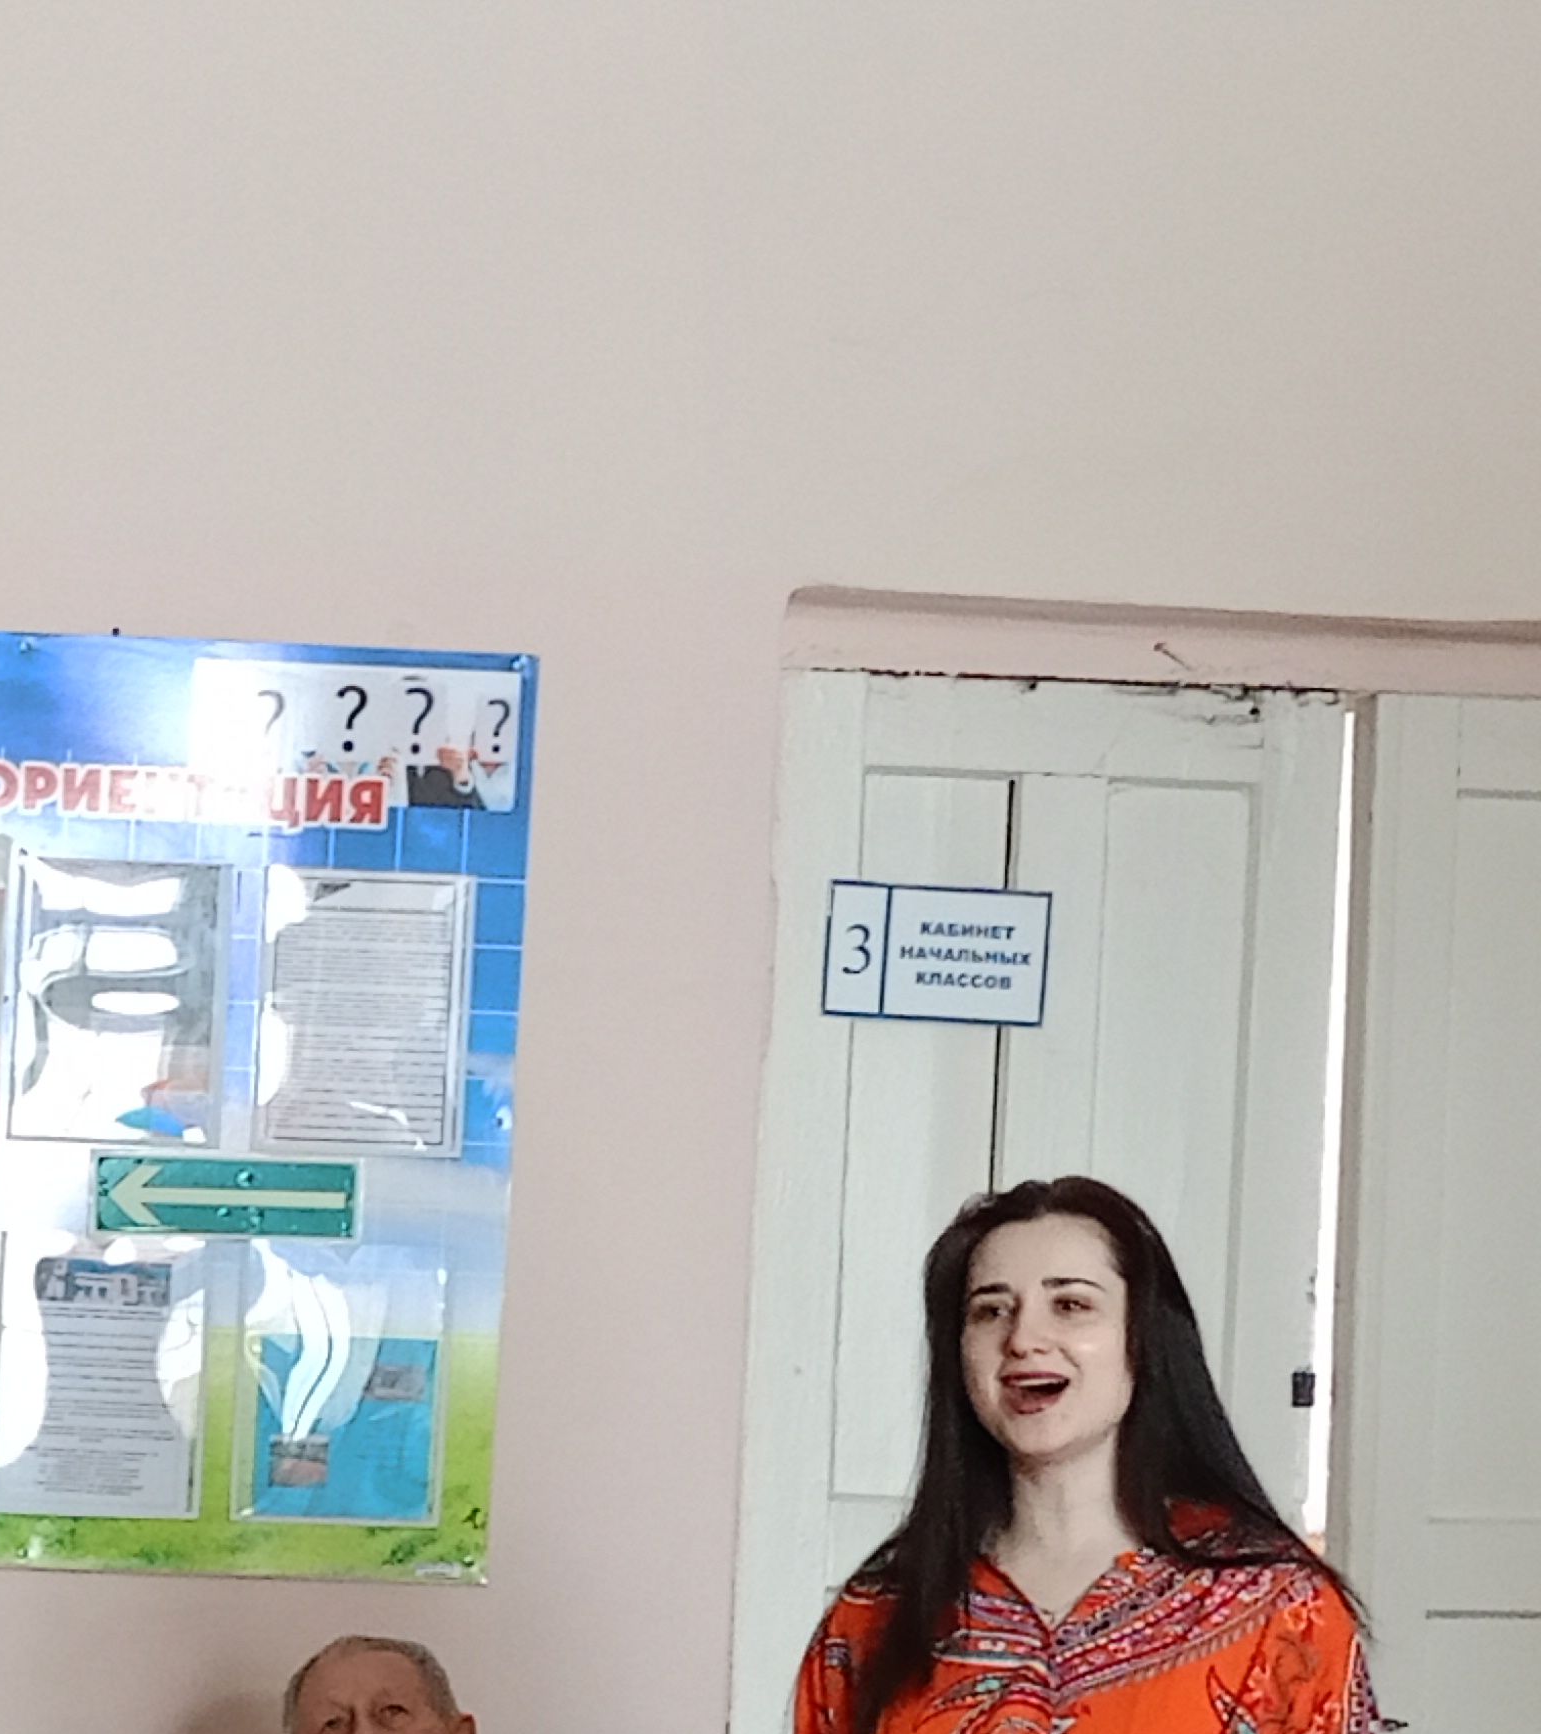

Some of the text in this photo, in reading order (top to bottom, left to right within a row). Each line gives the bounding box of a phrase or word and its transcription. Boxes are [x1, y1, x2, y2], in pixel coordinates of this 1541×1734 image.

[919, 921, 1017, 940] КАБИНЕТ
[841, 923, 872, 975] 3
[899, 945, 1033, 967] НАЧАЛЬНЫХ
[915, 971, 1013, 990] КЛАССОВ
